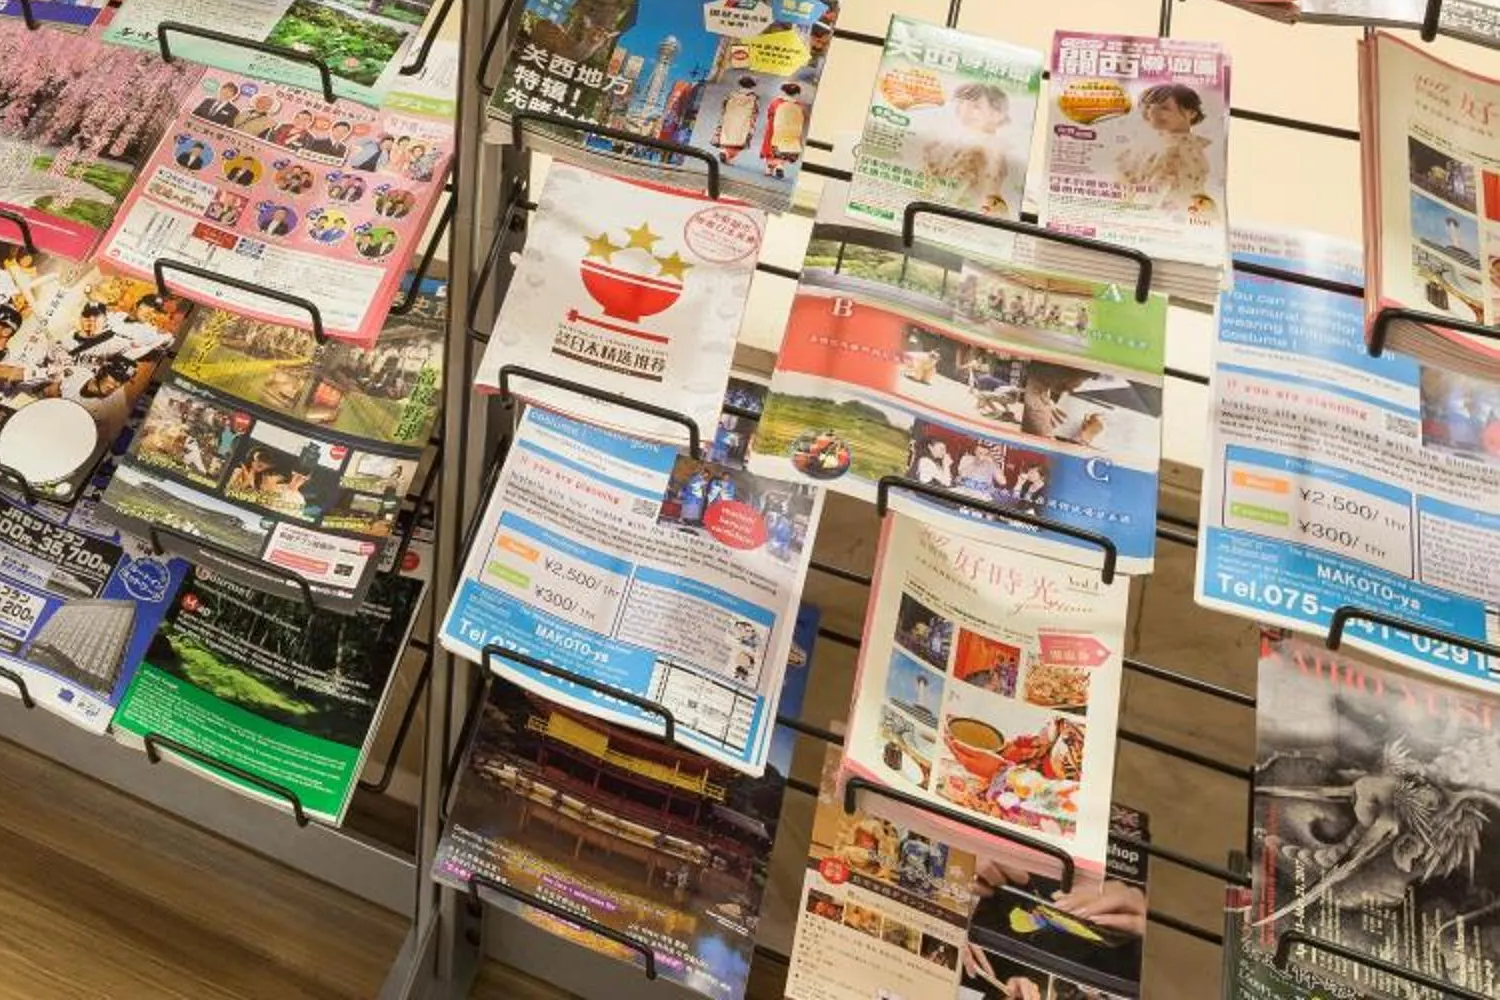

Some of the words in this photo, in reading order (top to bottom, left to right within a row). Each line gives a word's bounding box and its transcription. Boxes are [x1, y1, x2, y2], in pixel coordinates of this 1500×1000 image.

[831, 297, 853, 317] B
[1084, 459, 1113, 485] C
[1317, 565, 1421, 612] MAKOTO-ya
[535, 623, 609, 663] MAKOTO-ya
